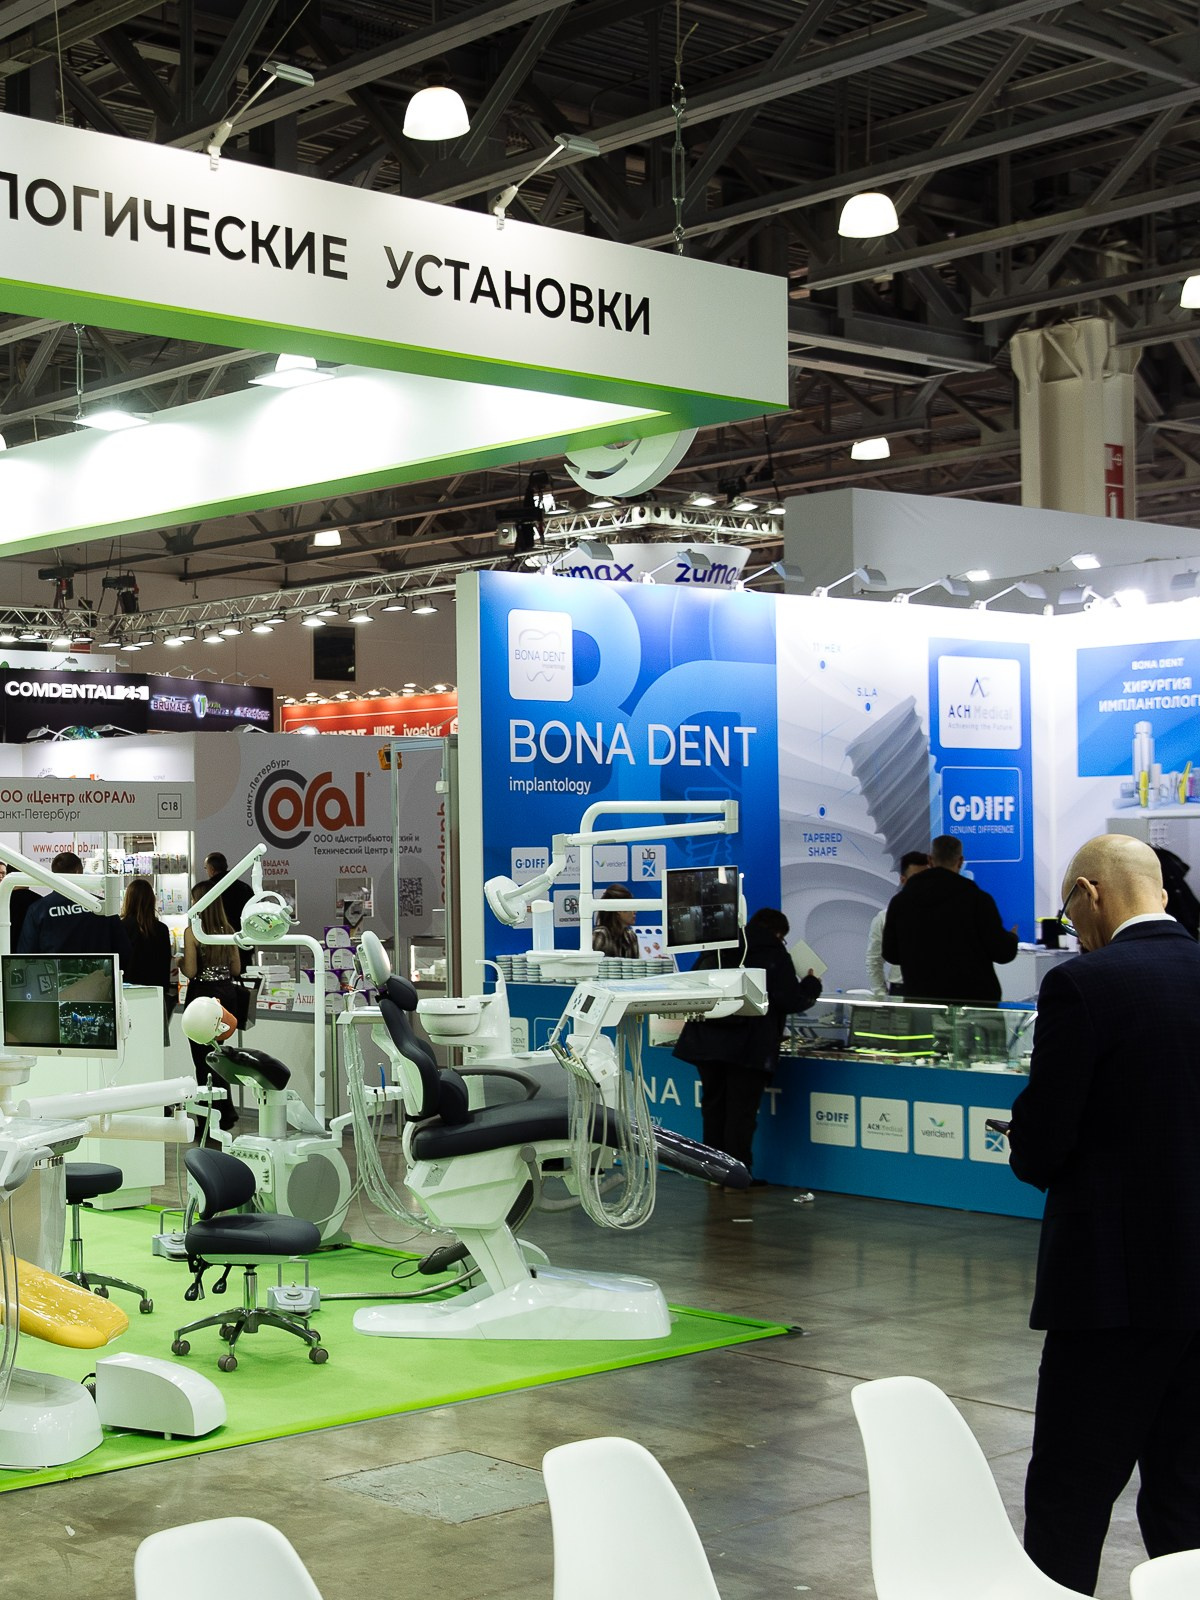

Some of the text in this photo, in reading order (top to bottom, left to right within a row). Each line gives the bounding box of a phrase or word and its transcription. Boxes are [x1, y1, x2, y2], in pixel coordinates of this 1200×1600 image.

[383, 246, 651, 337] УСТАНОВКИ
[675, 562, 740, 584] zuma
[515, 649, 565, 662] BONA DENT
[1132, 657, 1184, 671] BONA DENT
[1122, 677, 1193, 694] ХИРУРГИЯ
[1099, 694, 1200, 713] ИМПЛАНТОЛОГ
[948, 704, 1013, 721] ACH Medical
[509, 719, 758, 768] BONA DENT
[509, 776, 592, 796] implantology
[27, 790, 76, 807] «Центр
[78, 790, 136, 805] «КОРАЛ»
[246, 759, 290, 828] Санкт-Петербург
[161, 802, 179, 812] C18
[254, 770, 366, 850] Coral
[313, 834, 333, 844] ООО
[803, 832, 843, 843] TAPERED
[32, 841, 99, 856] www.coralpb.ru
[313, 846, 363, 857] Технический
[365, 847, 388, 858] Центр
[808, 846, 837, 857] SHAPE
[262, 860, 290, 868] ВЫДАЧА
[339, 865, 368, 874] КАССА
[263, 868, 289, 876] ТОВАРА
[642, 1076, 682, 1106] NA
[866, 1123, 880, 1131] ACH
[921, 1128, 955, 1140] verident
